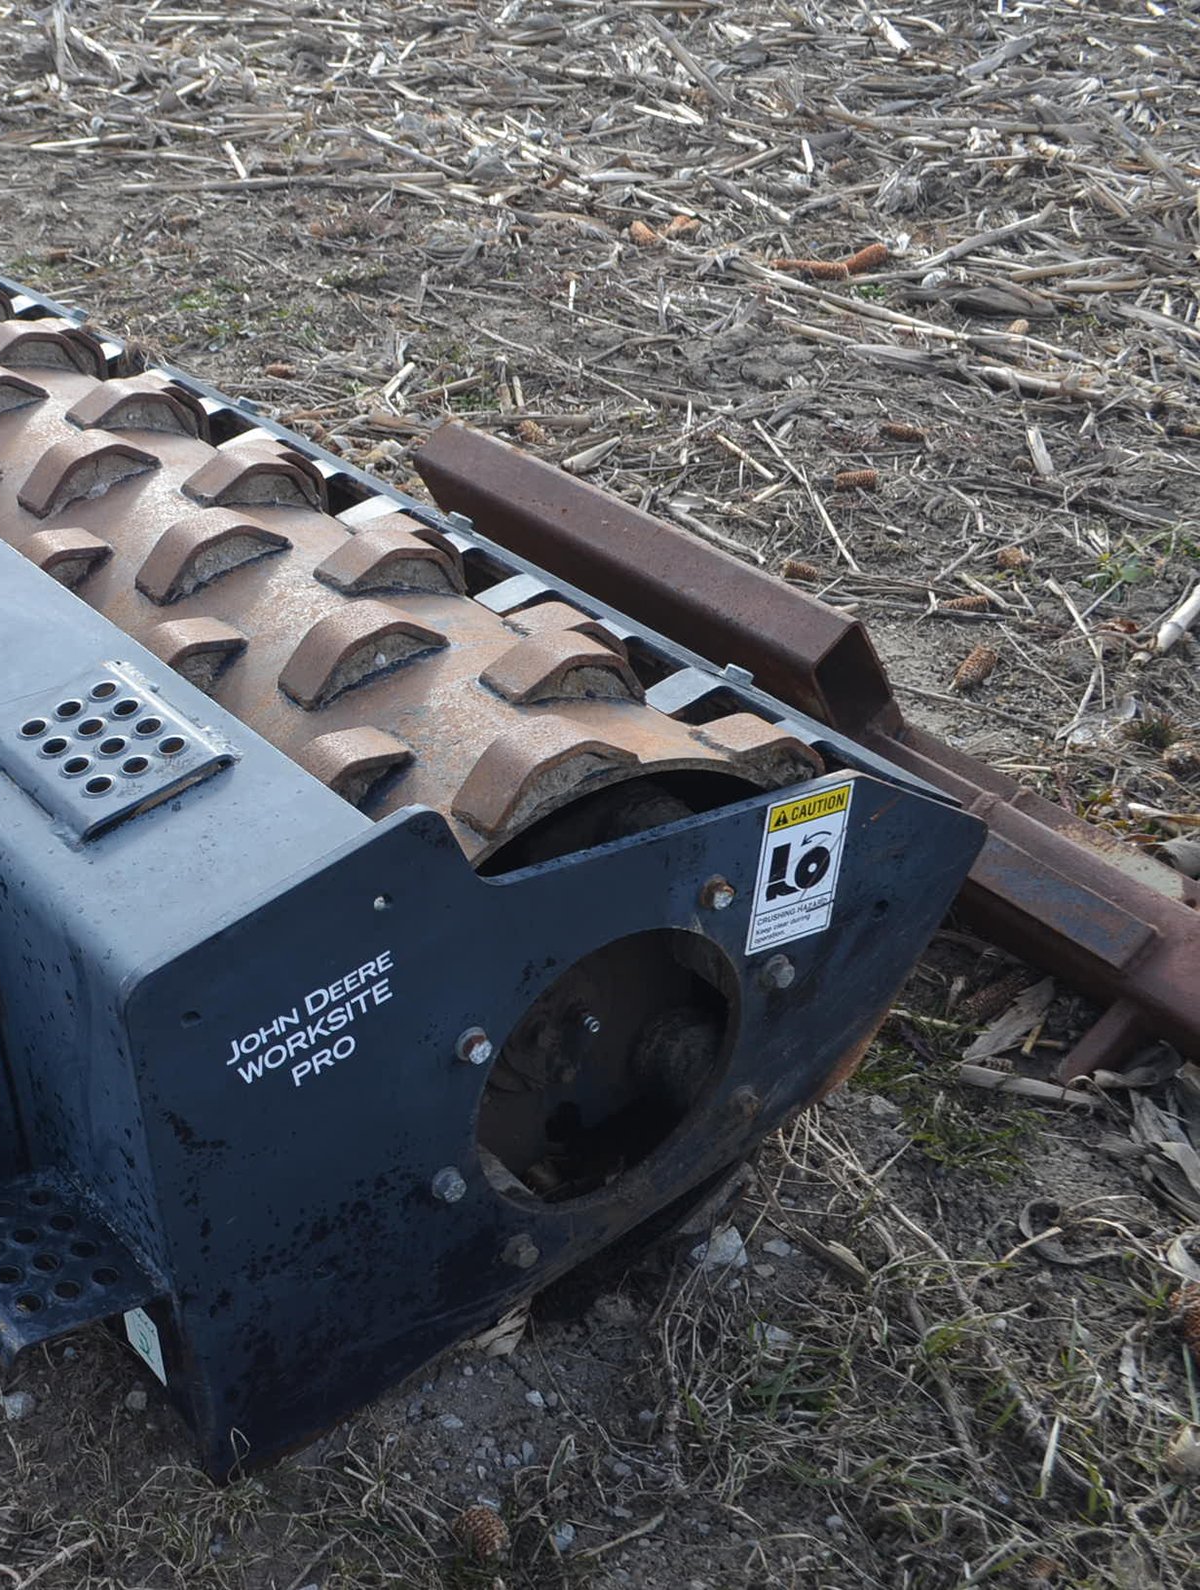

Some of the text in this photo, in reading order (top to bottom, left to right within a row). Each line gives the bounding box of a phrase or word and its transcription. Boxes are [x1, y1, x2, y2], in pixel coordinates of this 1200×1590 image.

[790, 792, 846, 821] CAUTION
[756, 910, 796, 927] CRUSHING
[225, 949, 394, 1066] JOHN DEERE
[236, 977, 394, 1085] WORKSITE
[290, 1034, 357, 1088] PRO
